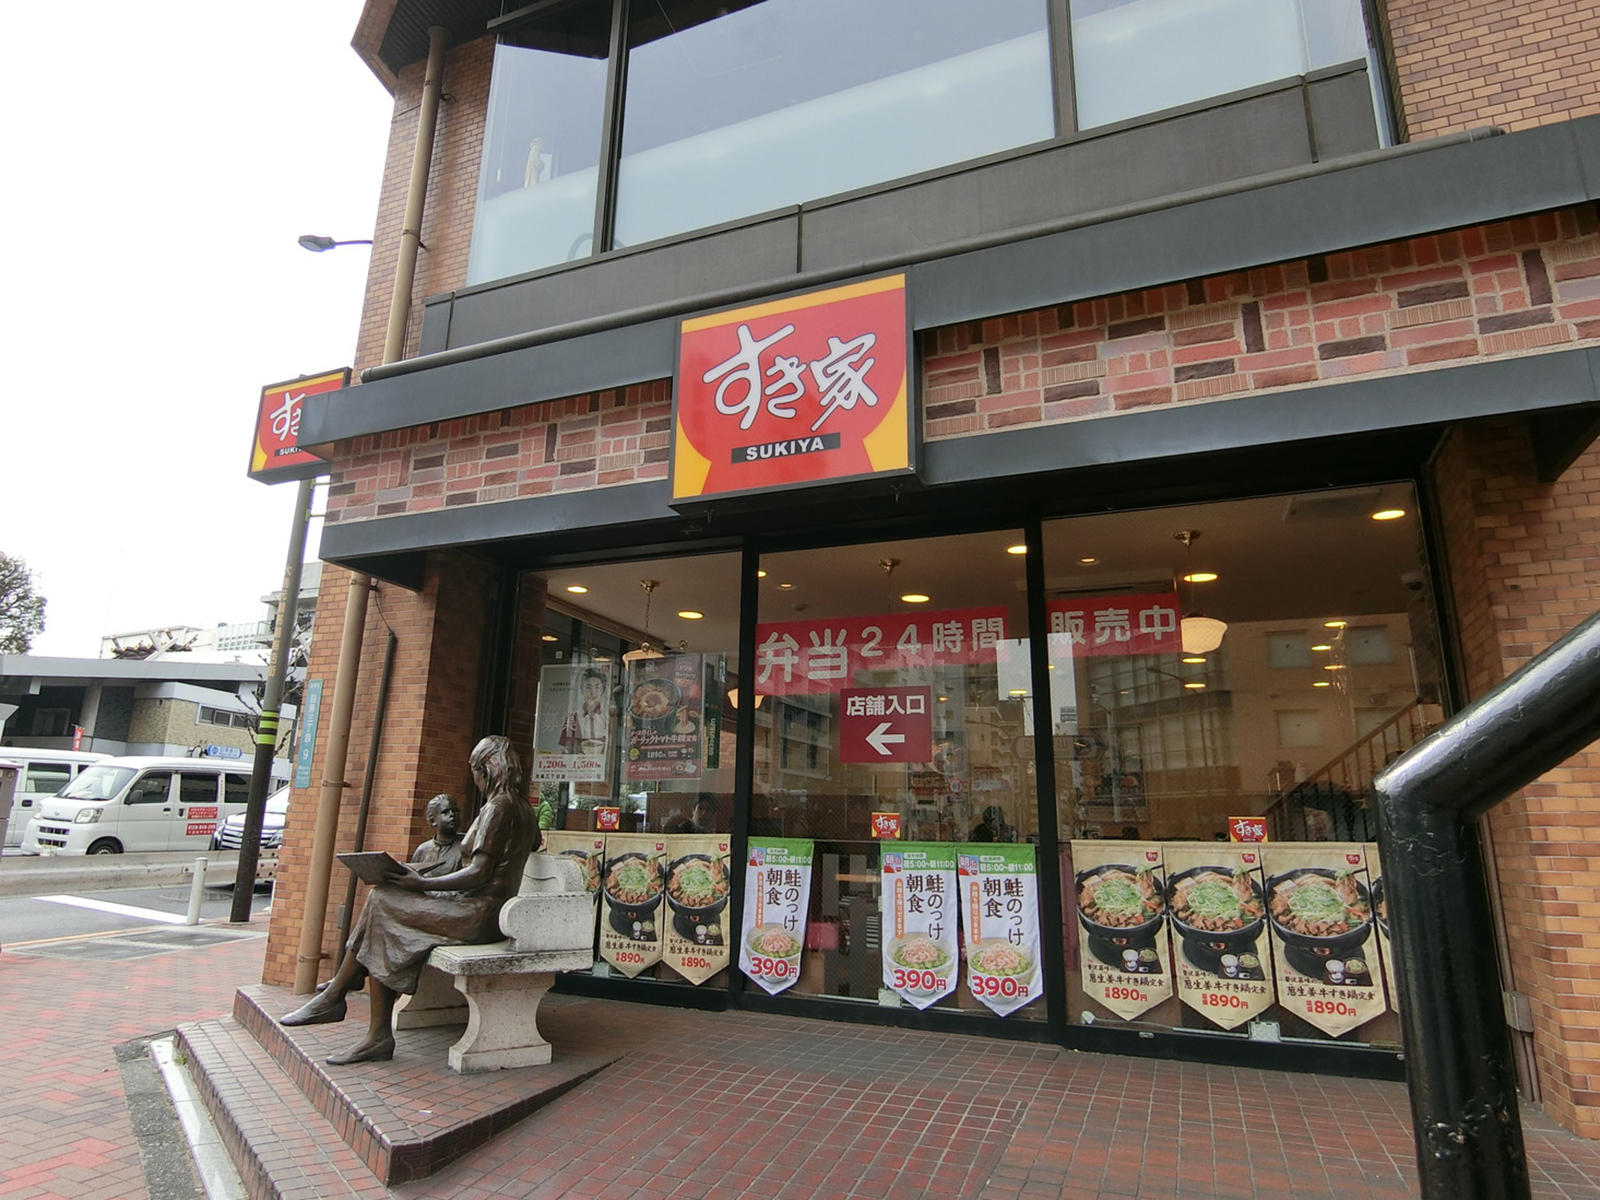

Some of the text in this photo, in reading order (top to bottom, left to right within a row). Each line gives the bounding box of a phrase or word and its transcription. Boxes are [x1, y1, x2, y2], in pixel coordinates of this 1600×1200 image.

[702, 323, 879, 432] すき家
[746, 436, 825, 461] SUKIYA
[1050, 605, 1177, 647] 販売中
[846, 694, 926, 716] 店舗入口
[304, 693, 317, 743] 目黒三丁目
[302, 749, 309, 760] 9
[875, 815, 898, 831] すき家
[1233, 819, 1264, 838] すき家
[765, 868, 783, 906] 朝食
[905, 873, 925, 914] 朝食
[982, 877, 1003, 919] 朝食
[784, 869, 802, 932] 鮭のっけ
[925, 873, 945, 941] 鮭のっけ
[1003, 877, 1024, 946] 鮭のっけ
[620, 952, 646, 964] 890円
[686, 956, 712, 969] 890円
[749, 956, 798, 978] 390円
[893, 968, 947, 991] 390円
[972, 975, 1029, 997] 390円
[1111, 986, 1148, 1002] 890円
[1209, 993, 1249, 1009] 890円
[1313, 1000, 1357, 1017] 890円
